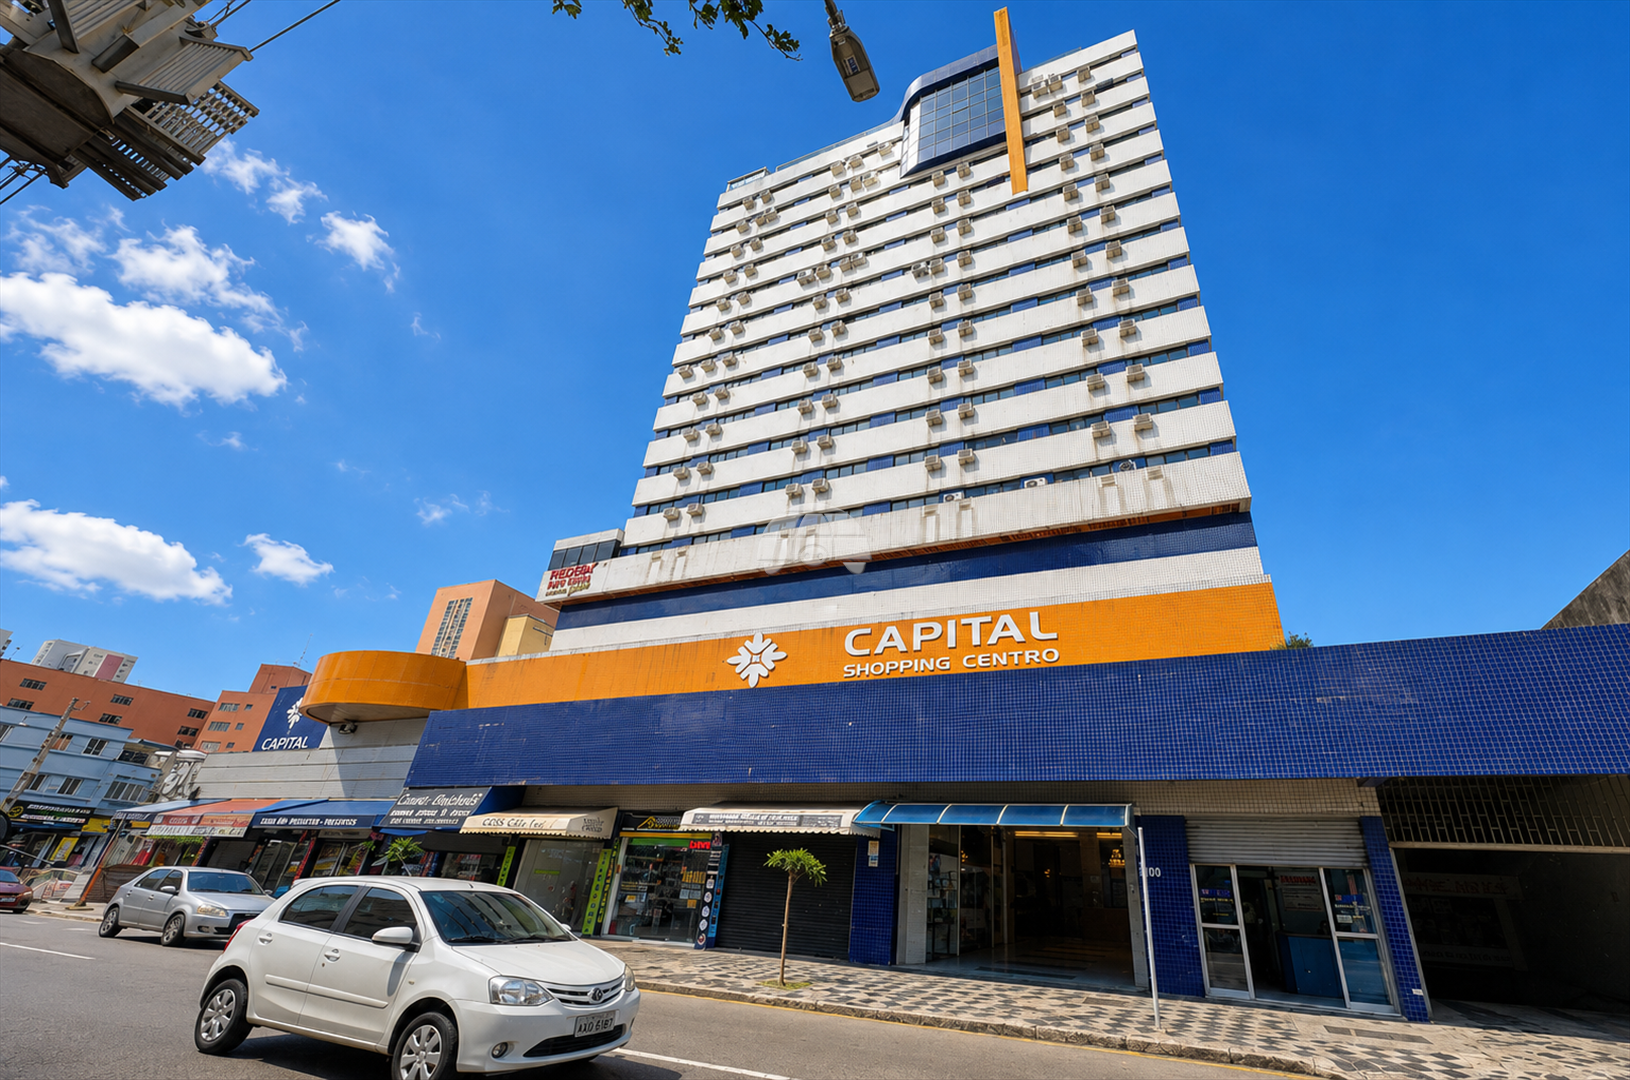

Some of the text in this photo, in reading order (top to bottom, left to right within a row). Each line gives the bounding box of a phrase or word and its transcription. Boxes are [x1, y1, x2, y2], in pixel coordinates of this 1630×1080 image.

[844, 611, 1059, 656] CAPITAL
[843, 648, 1060, 678] SHOPPING CENTRO
[261, 736, 309, 751] CAPITAL
